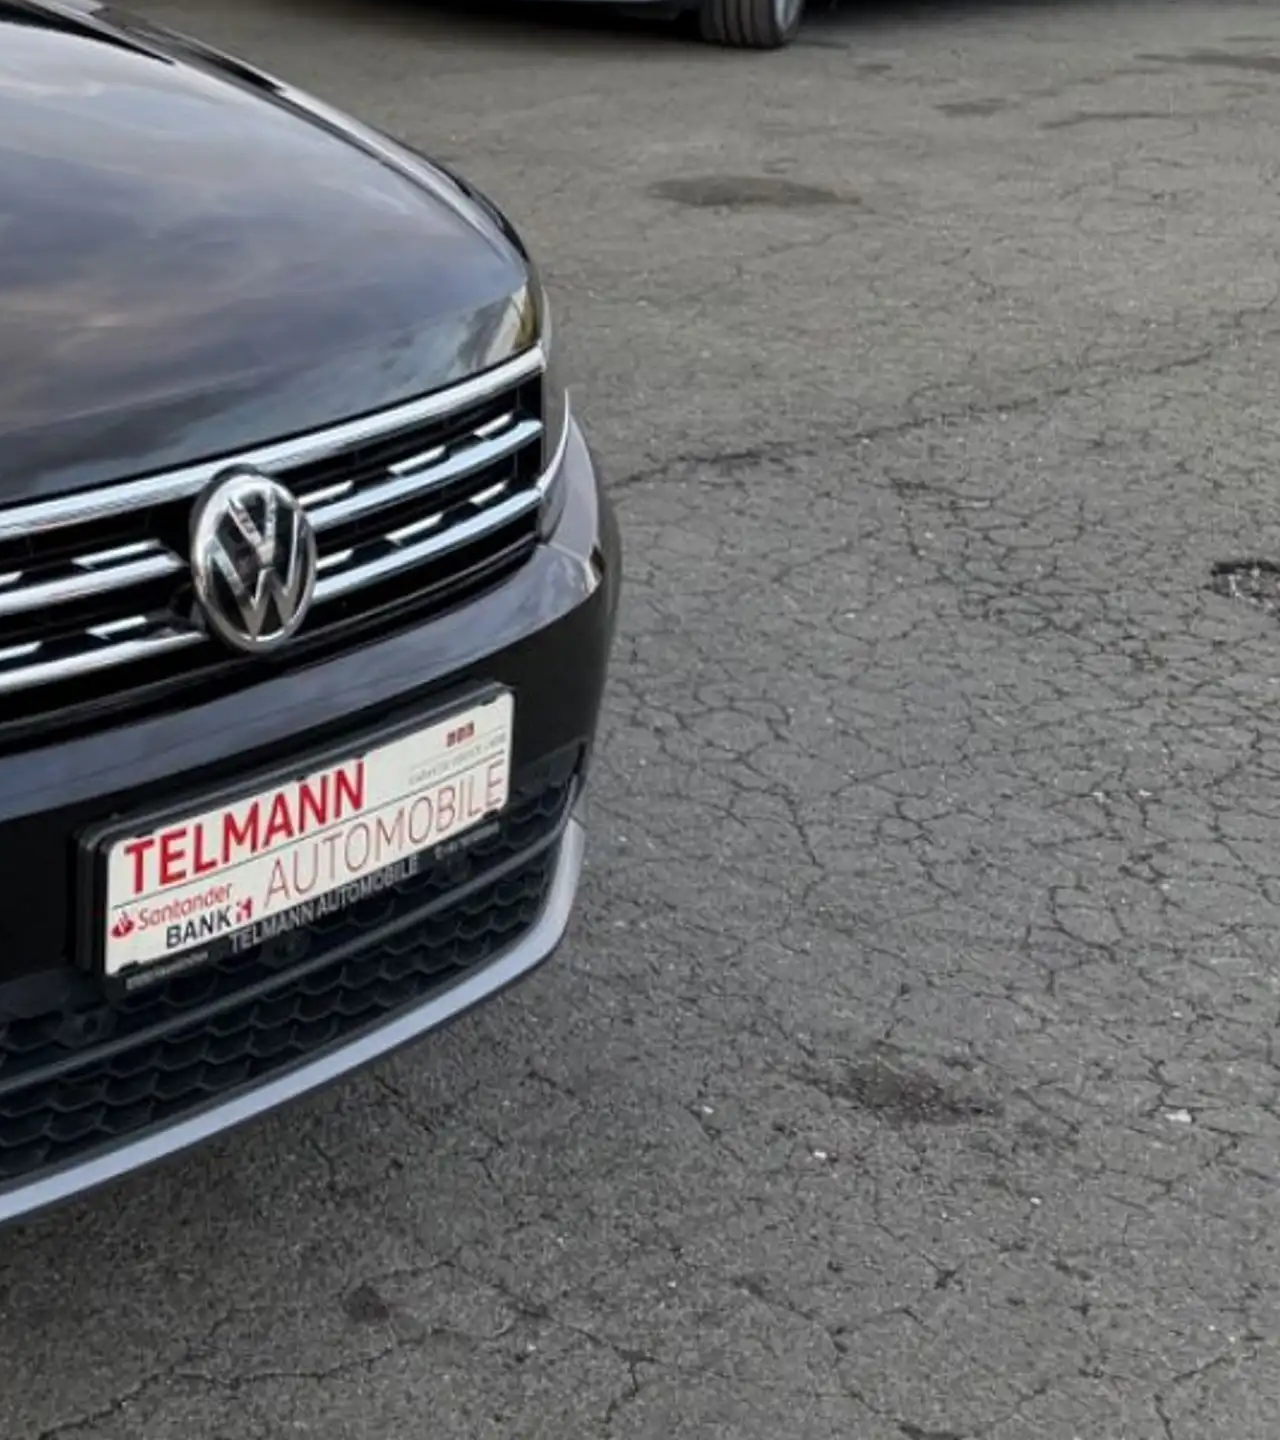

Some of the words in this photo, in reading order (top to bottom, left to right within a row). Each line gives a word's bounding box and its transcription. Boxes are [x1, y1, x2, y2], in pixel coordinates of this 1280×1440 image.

[124, 759, 365, 895] TELMANN
[263, 759, 506, 909] AUTOMOBILE
[138, 883, 233, 931] Santander
[166, 904, 232, 949] BANK
[229, 901, 315, 953] TELMANN
[316, 855, 419, 917] AUTOMOBILE
